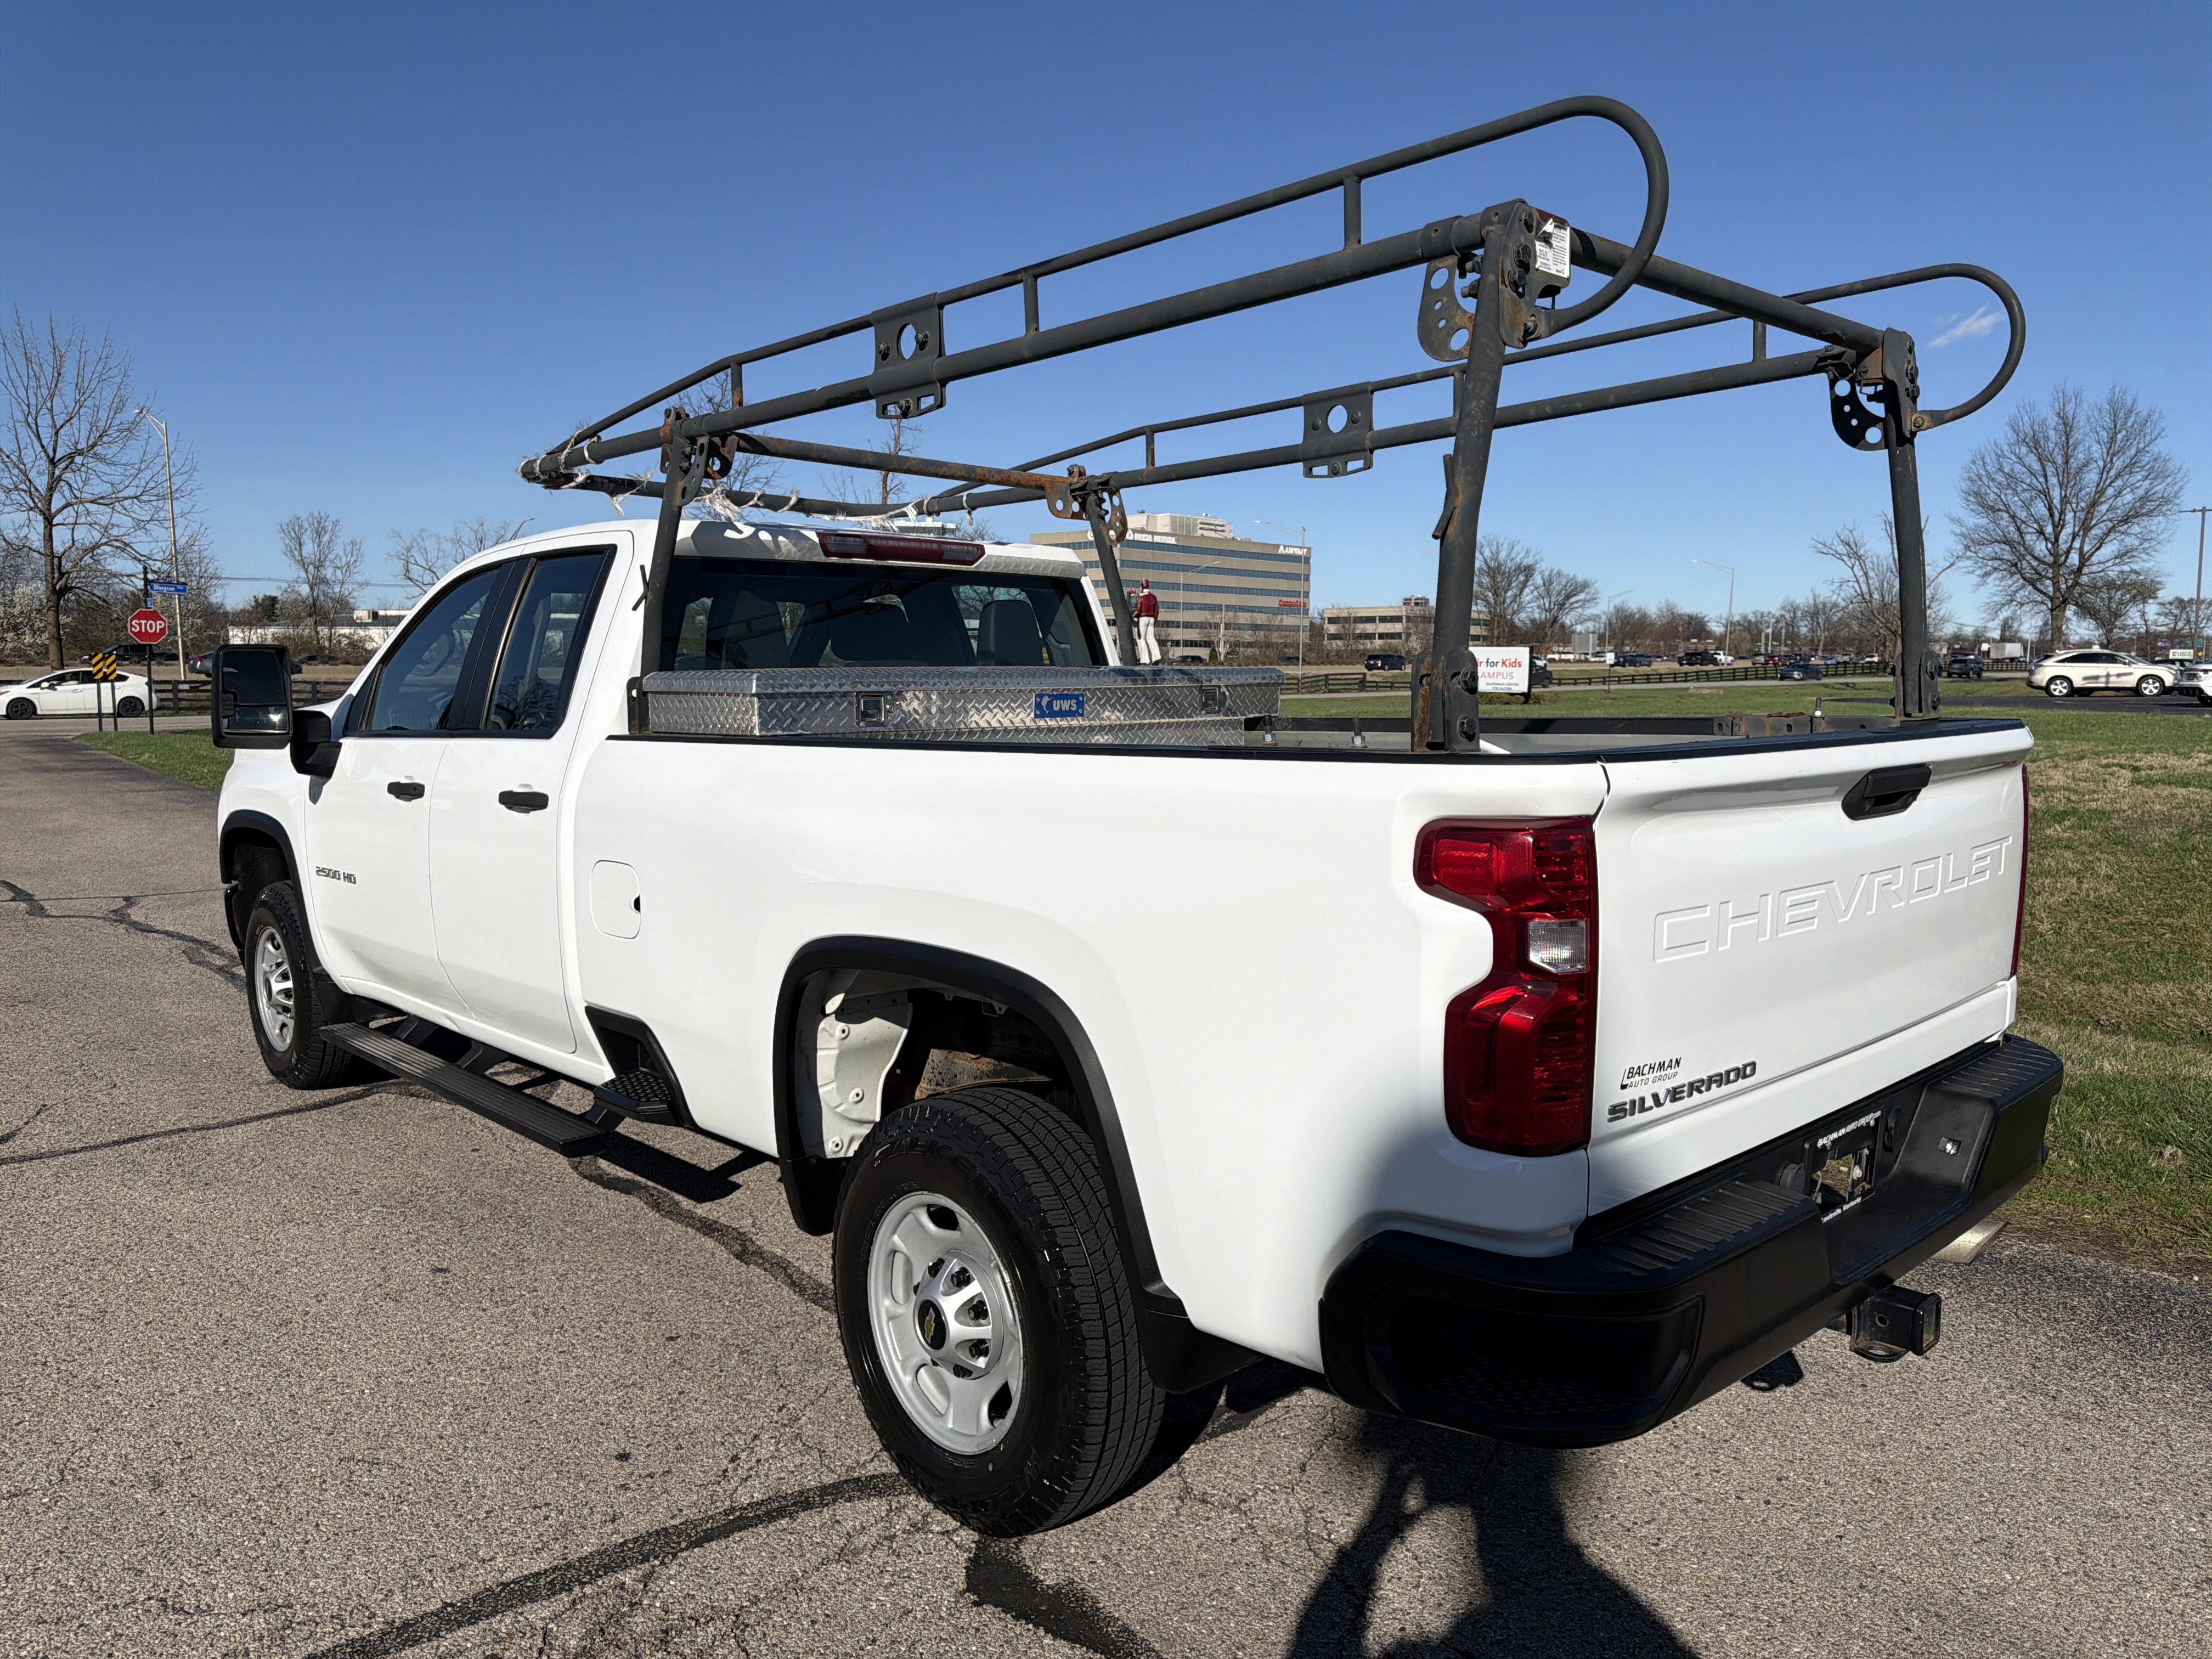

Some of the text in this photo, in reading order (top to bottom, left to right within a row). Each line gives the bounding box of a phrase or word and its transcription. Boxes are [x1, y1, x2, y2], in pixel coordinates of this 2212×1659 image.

[132, 619, 165, 633] STOP
[1486, 658, 1500, 668] for
[1501, 658, 1522, 668] Kids
[1480, 672, 1514, 680] AMPUS
[1053, 699, 1077, 711] UWS
[315, 866, 357, 885] 2500 HD
[1653, 835, 2013, 963] CHEVROLET
[1627, 1057, 1682, 1080] BACHMAN
[1628, 1071, 1678, 1090] AUTO GROUP
[1607, 1060, 1757, 1123] SILVERADO
[1817, 1127, 1846, 1148] BACHMAN
